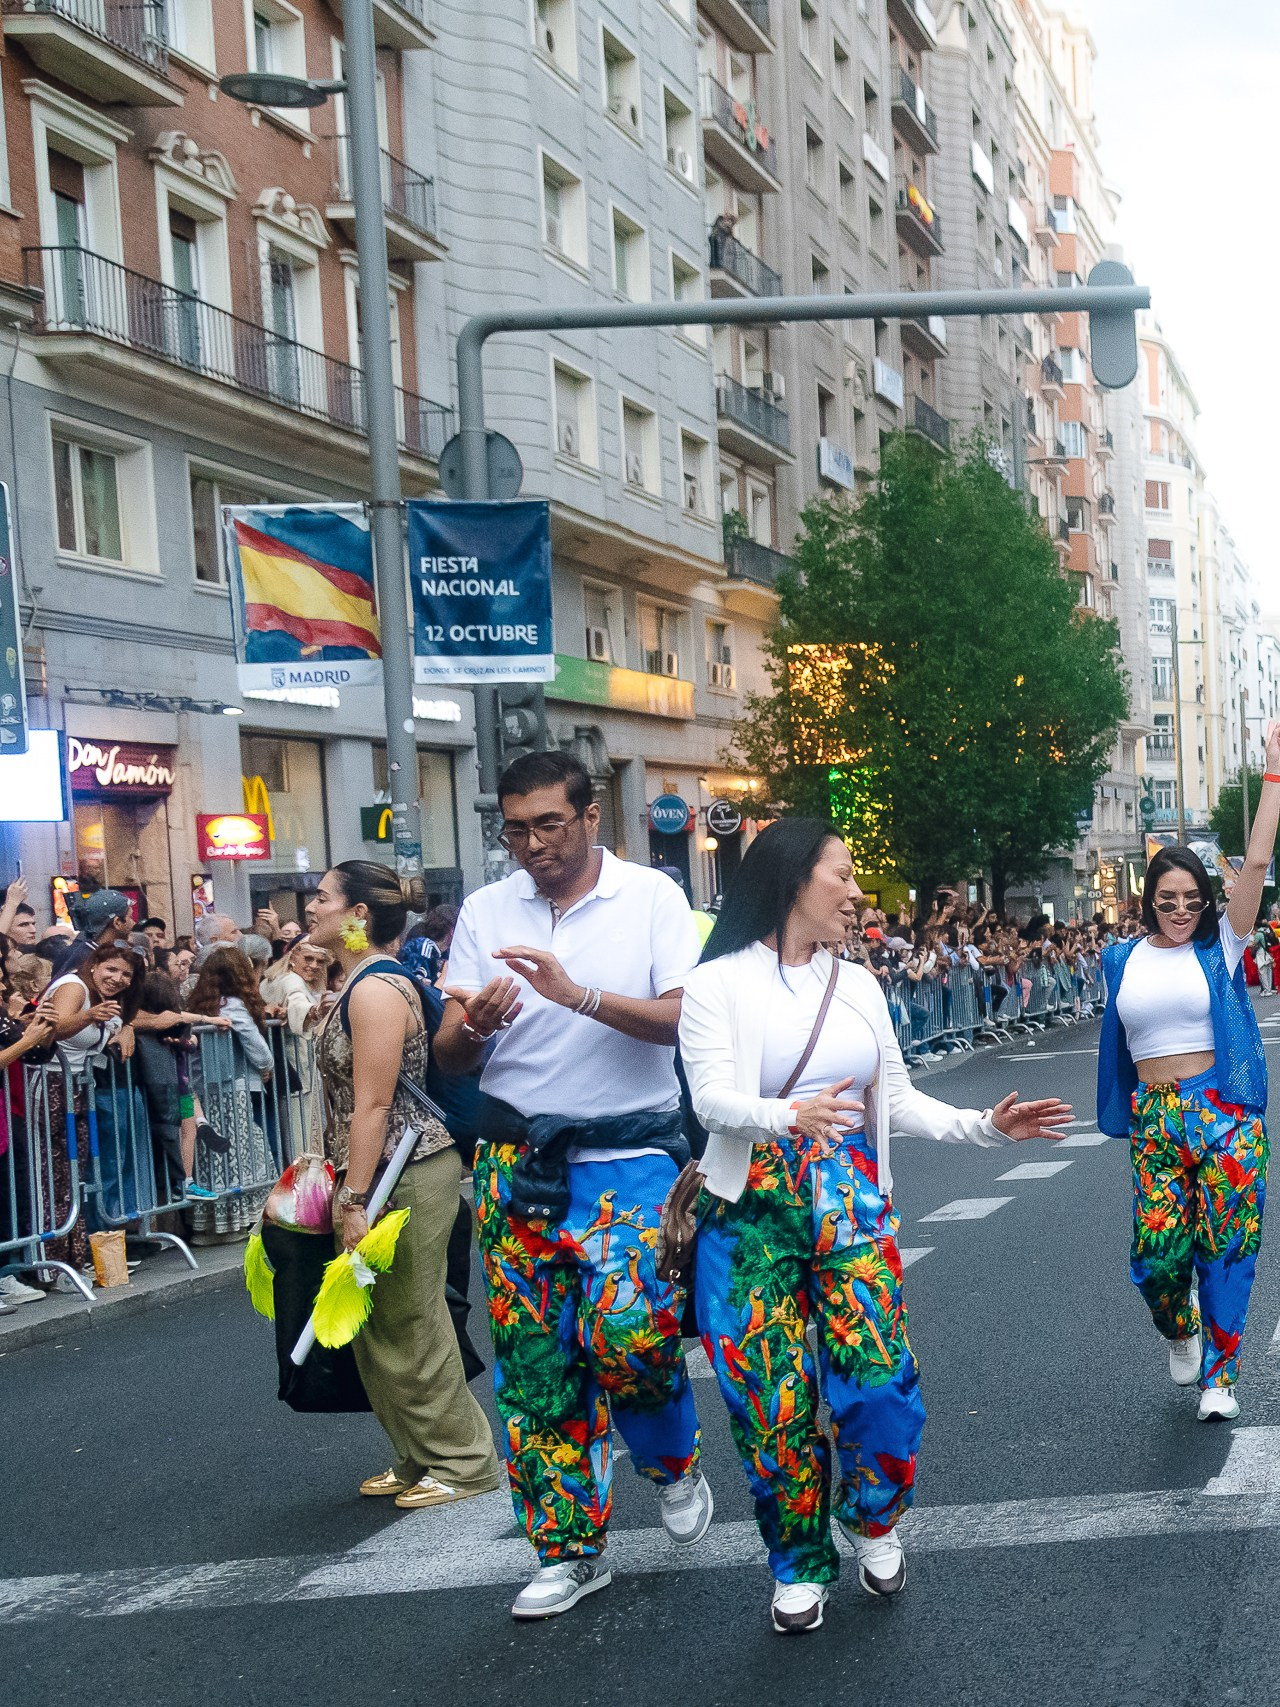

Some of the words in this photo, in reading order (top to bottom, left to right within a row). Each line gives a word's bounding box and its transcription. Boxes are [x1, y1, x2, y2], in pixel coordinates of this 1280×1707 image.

[420, 556, 478, 573] FIESTA
[421, 579, 520, 596] NACIONAL
[424, 624, 445, 641] 12
[449, 624, 538, 645] OCTUBRE
[289, 670, 350, 684] MADRID
[497, 666, 511, 674] LOS
[512, 666, 546, 674] CAMINOS
[68, 737, 108, 773] Don
[95, 746, 176, 786] Jamón
